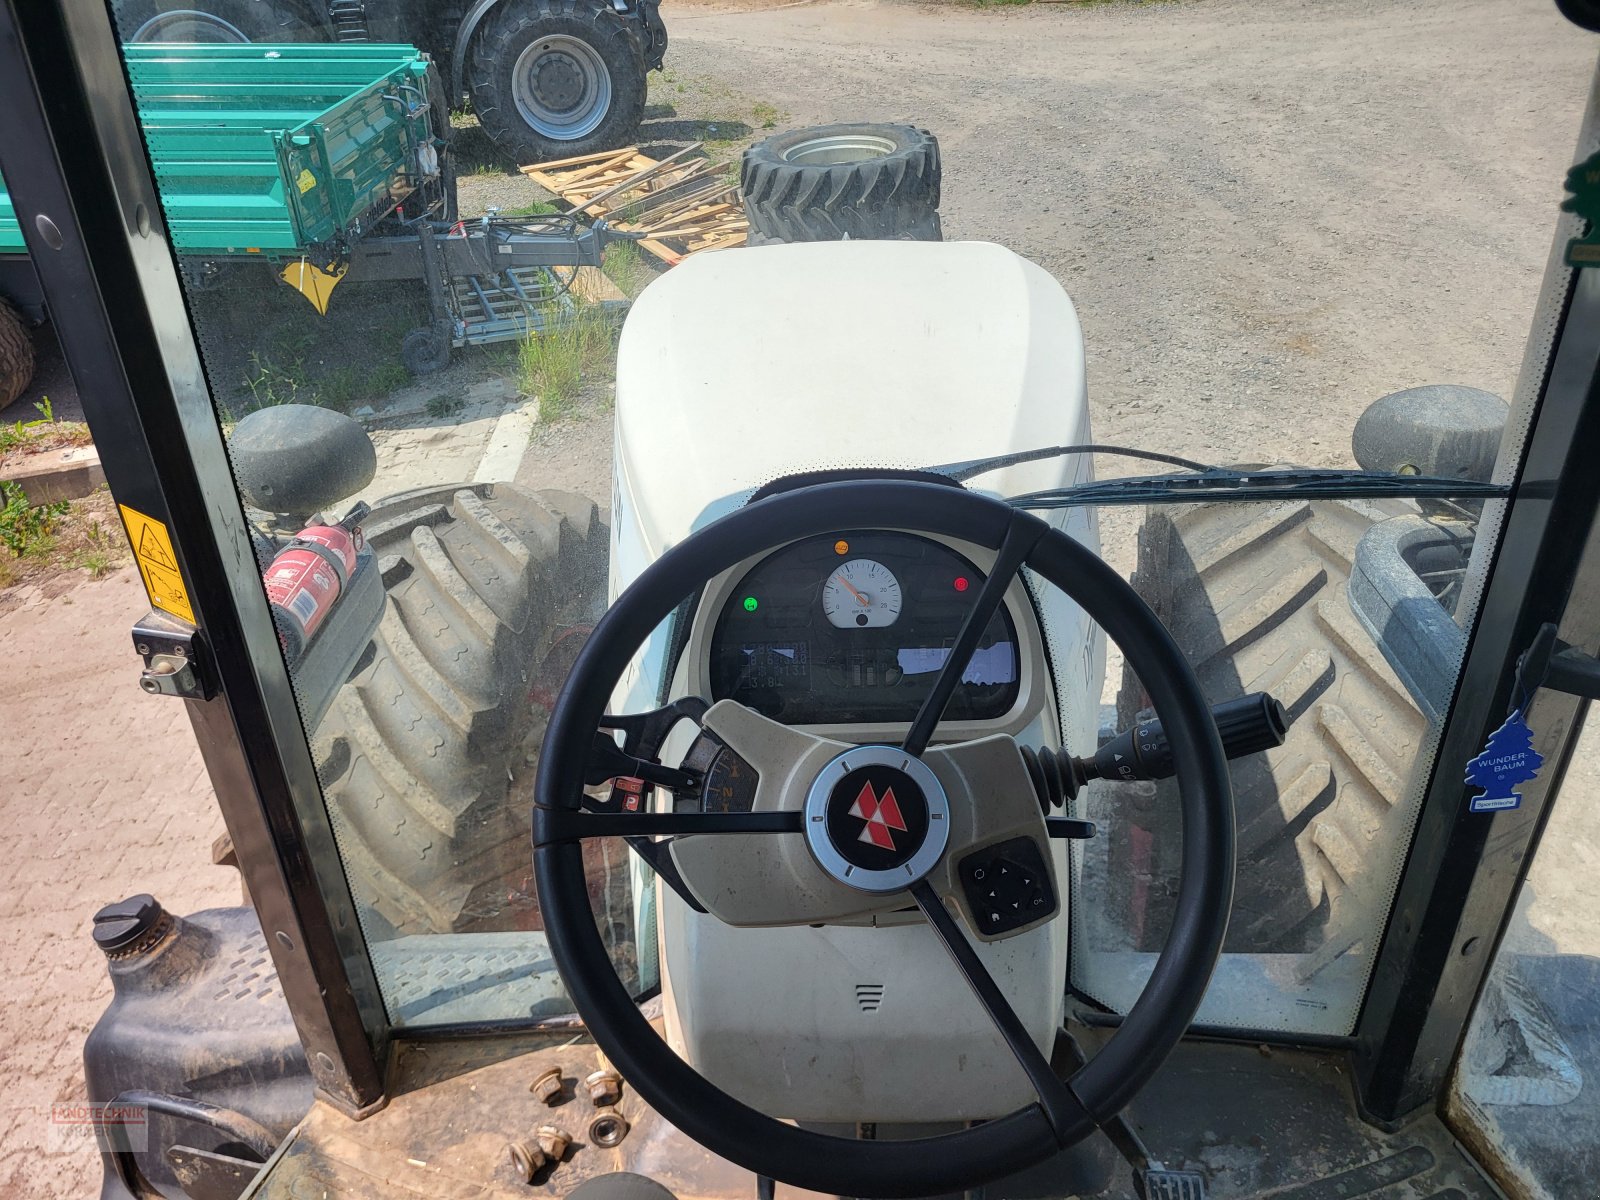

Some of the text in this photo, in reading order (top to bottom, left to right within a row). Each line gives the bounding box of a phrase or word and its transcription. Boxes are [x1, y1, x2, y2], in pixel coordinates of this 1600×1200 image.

[1478, 752, 1529, 767] WUNDER-
[1493, 760, 1525, 773] BAUM
[626, 796, 636, 807] P
